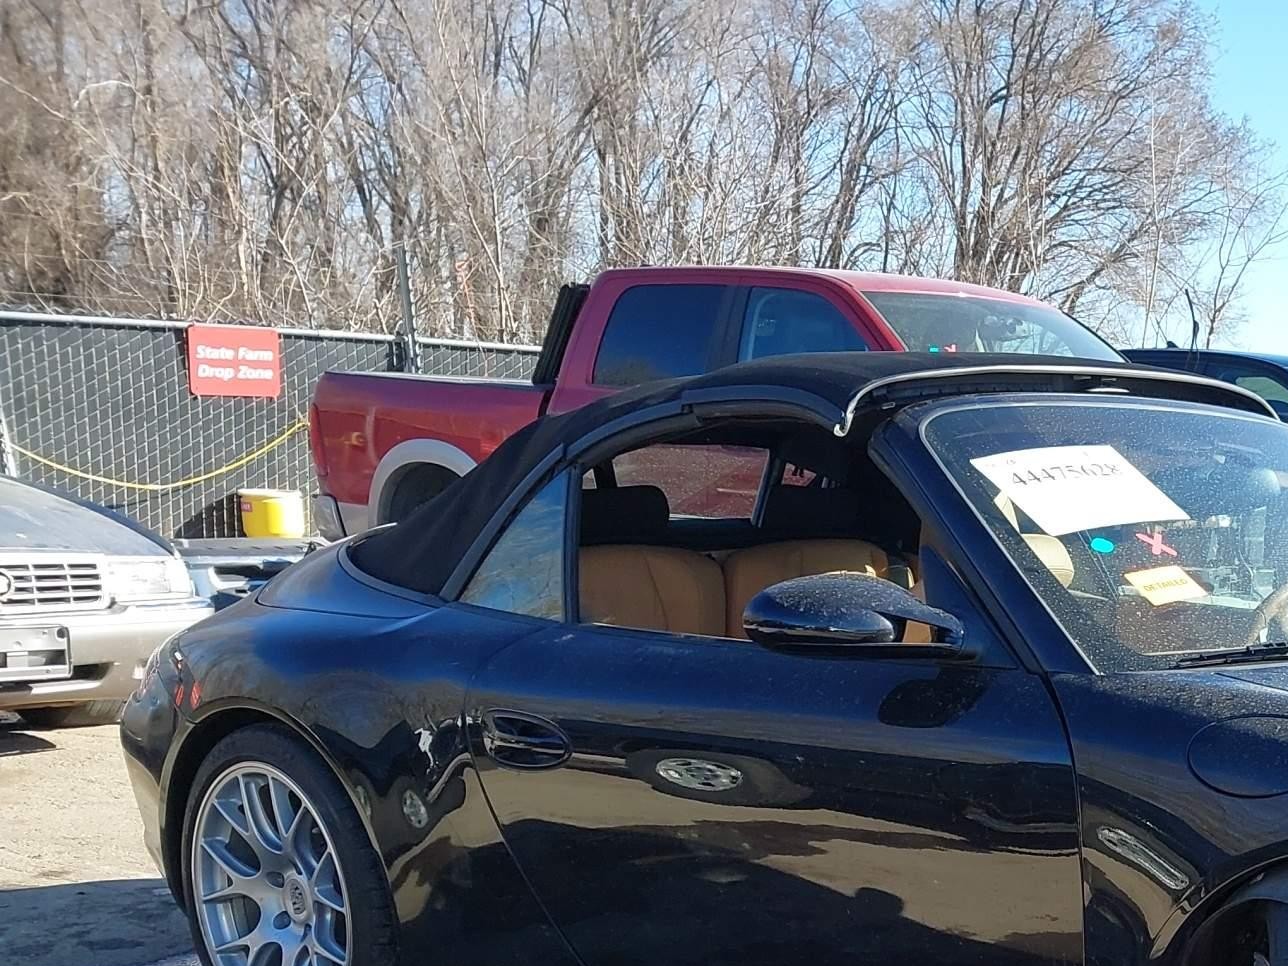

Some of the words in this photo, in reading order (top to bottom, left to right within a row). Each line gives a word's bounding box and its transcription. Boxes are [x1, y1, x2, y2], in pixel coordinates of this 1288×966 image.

[196, 345, 234, 360] State
[238, 347, 273, 361] Farm
[197, 364, 234, 381] Drop
[237, 365, 273, 380] Zone
